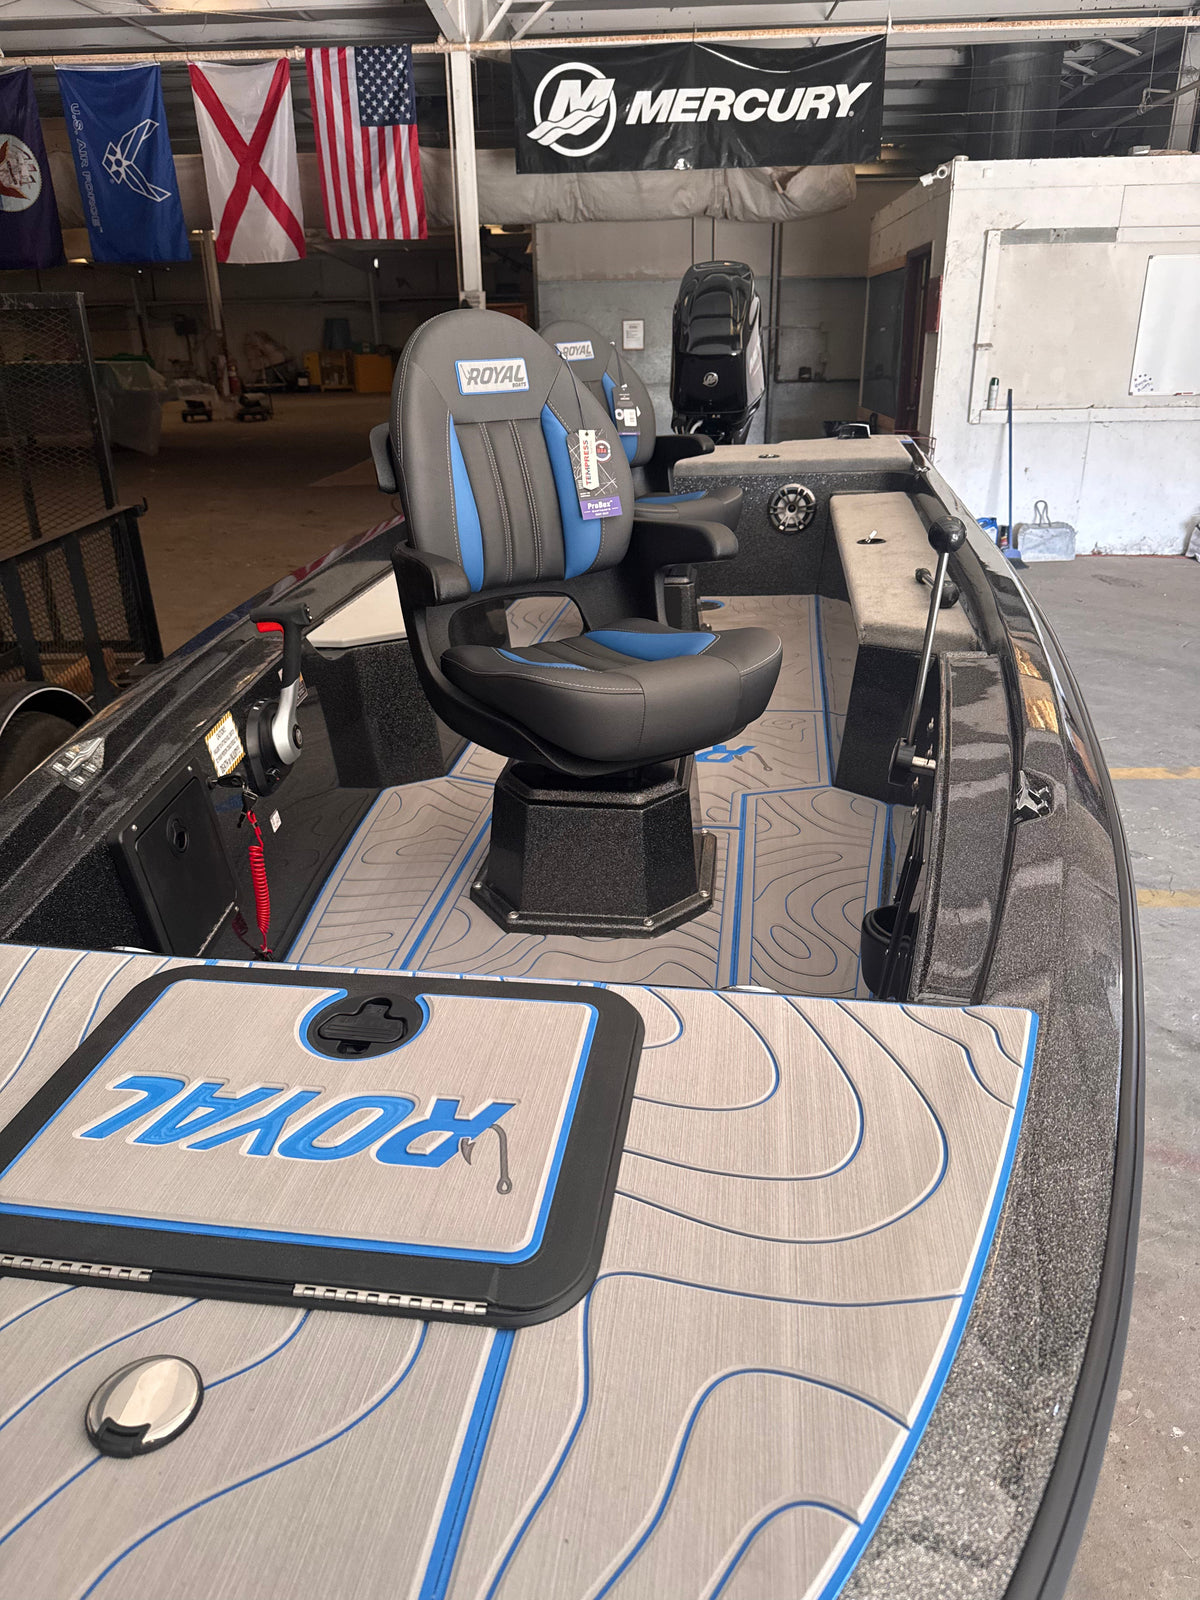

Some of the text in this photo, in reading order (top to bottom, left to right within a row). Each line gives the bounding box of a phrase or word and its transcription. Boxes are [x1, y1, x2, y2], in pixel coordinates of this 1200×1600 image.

[626, 82, 872, 125] MERCURY
[70, 102, 101, 228] U.S. AIR FORCE
[466, 365, 525, 385] ROYAL
[583, 440, 592, 486] TEMPRESS
[79, 1074, 518, 1169] ROYAL
